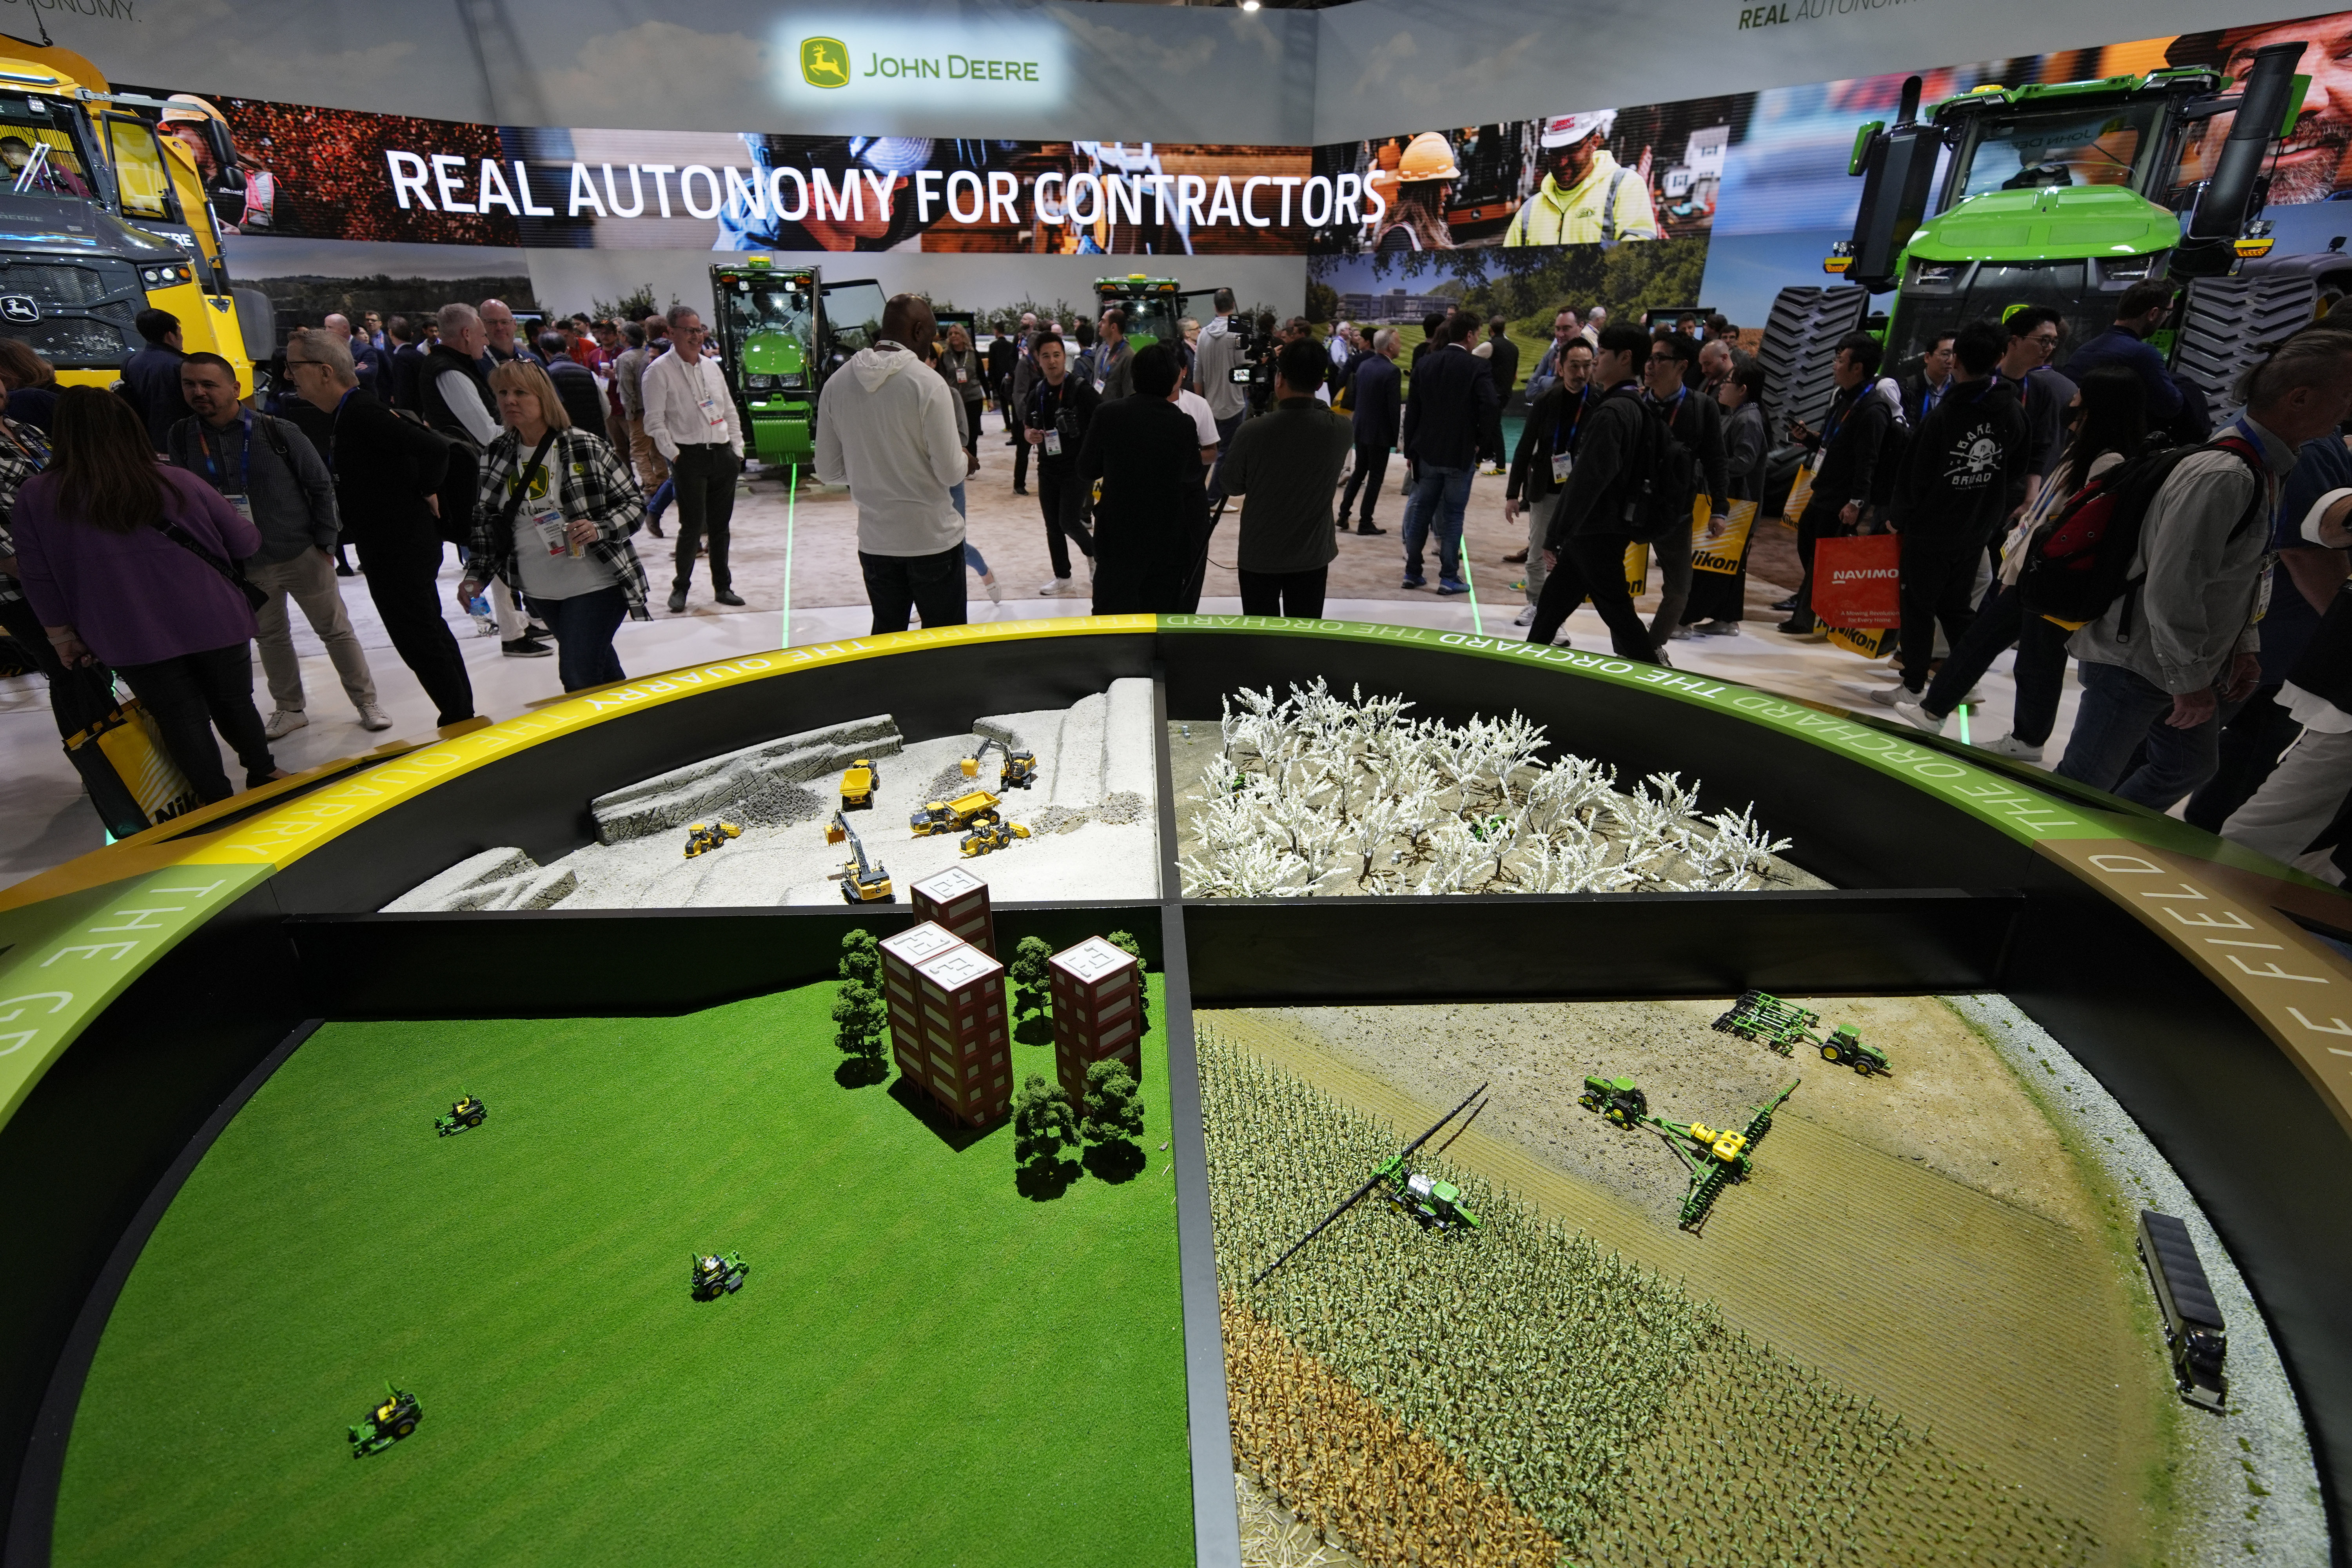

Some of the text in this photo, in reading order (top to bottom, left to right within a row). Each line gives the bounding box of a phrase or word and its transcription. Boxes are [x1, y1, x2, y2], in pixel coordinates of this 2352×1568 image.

[1739, 4, 1789, 30] REAL
[864, 53, 1039, 82] JOHN DEERE
[386, 151, 1387, 227] REAL AUTONOMY FOR CONTRACTORS
[1833, 569, 1899, 579] NAVIMO
[890, 615, 1145, 646] THE QUARRY
[1167, 616, 1425, 640] THE ORCHARD
[583, 641, 875, 711] THE QUARRY
[1439, 633, 1726, 699] THE ORCHARD
[224, 713, 579, 856] THE QUARRY
[1732, 696, 2078, 832] THE ORCHARD
[154, 791, 201, 824] Nik
[39, 879, 227, 967] THE
[2088, 855, 2330, 984] FIELD
